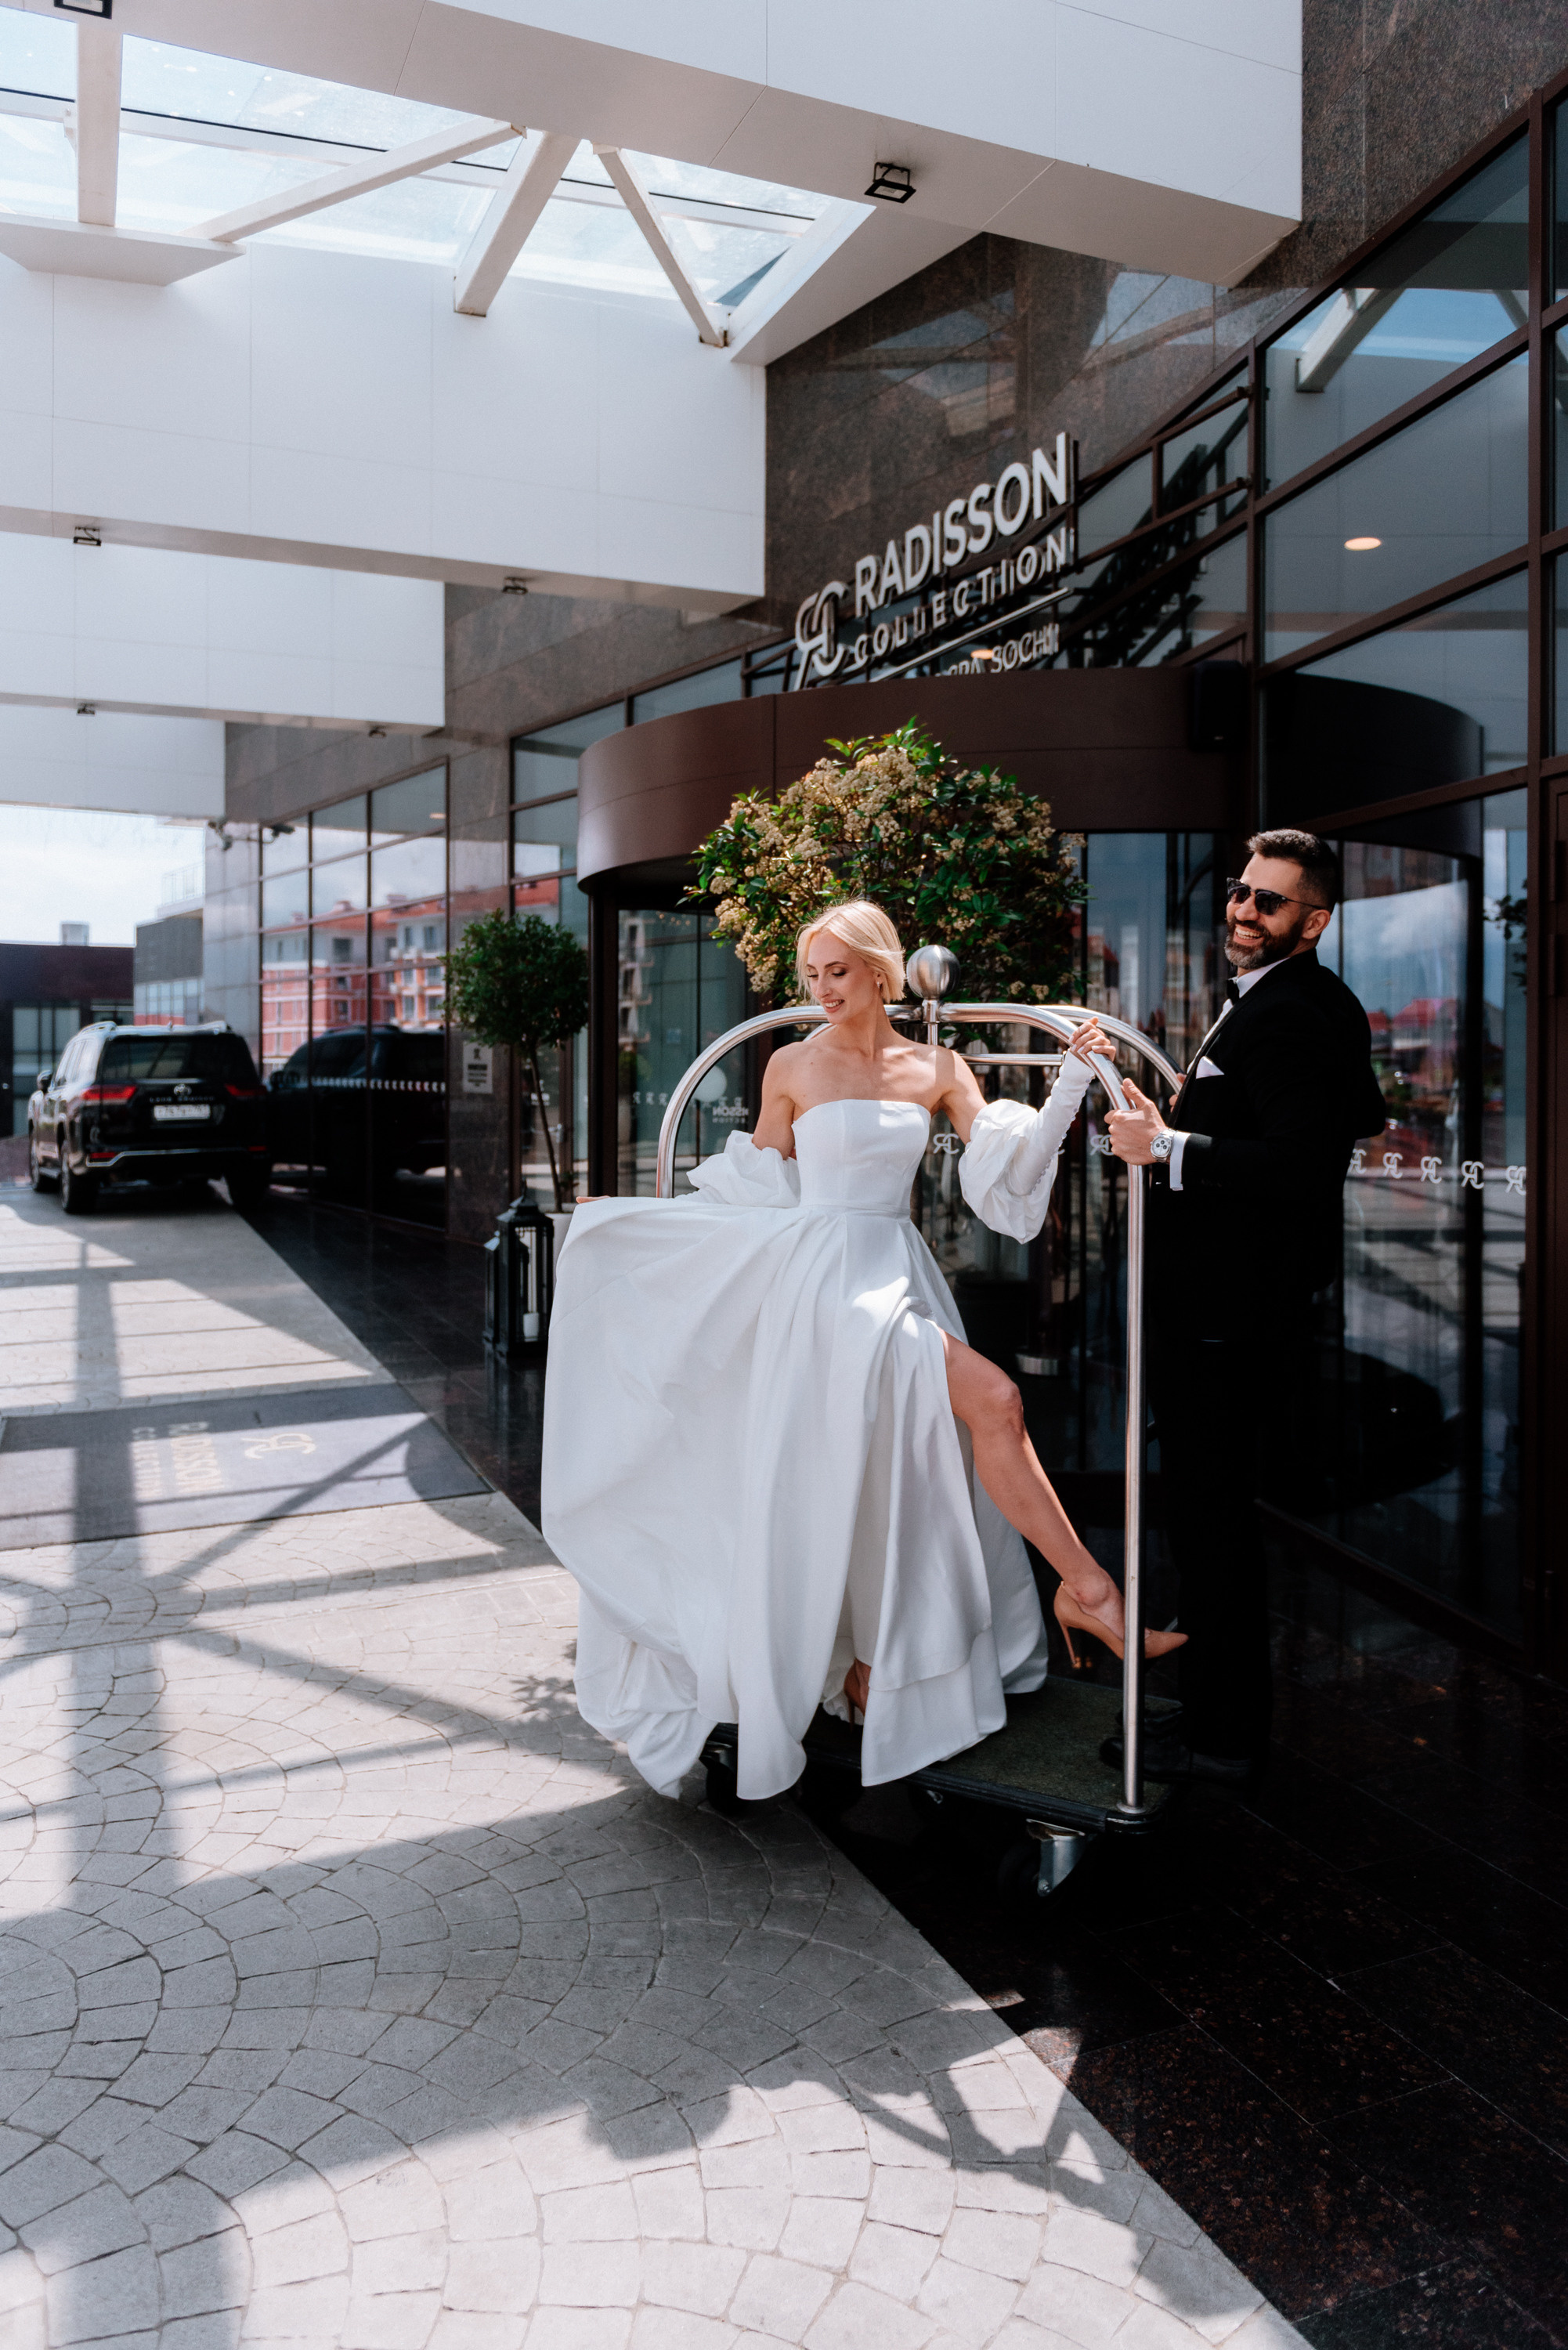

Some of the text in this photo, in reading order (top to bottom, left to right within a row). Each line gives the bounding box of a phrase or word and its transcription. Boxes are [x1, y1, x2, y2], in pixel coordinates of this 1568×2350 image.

[855, 432, 1071, 617] RADISSON
[854, 526, 1071, 667] COLLECTION
[990, 623, 1058, 674] SOCHI
